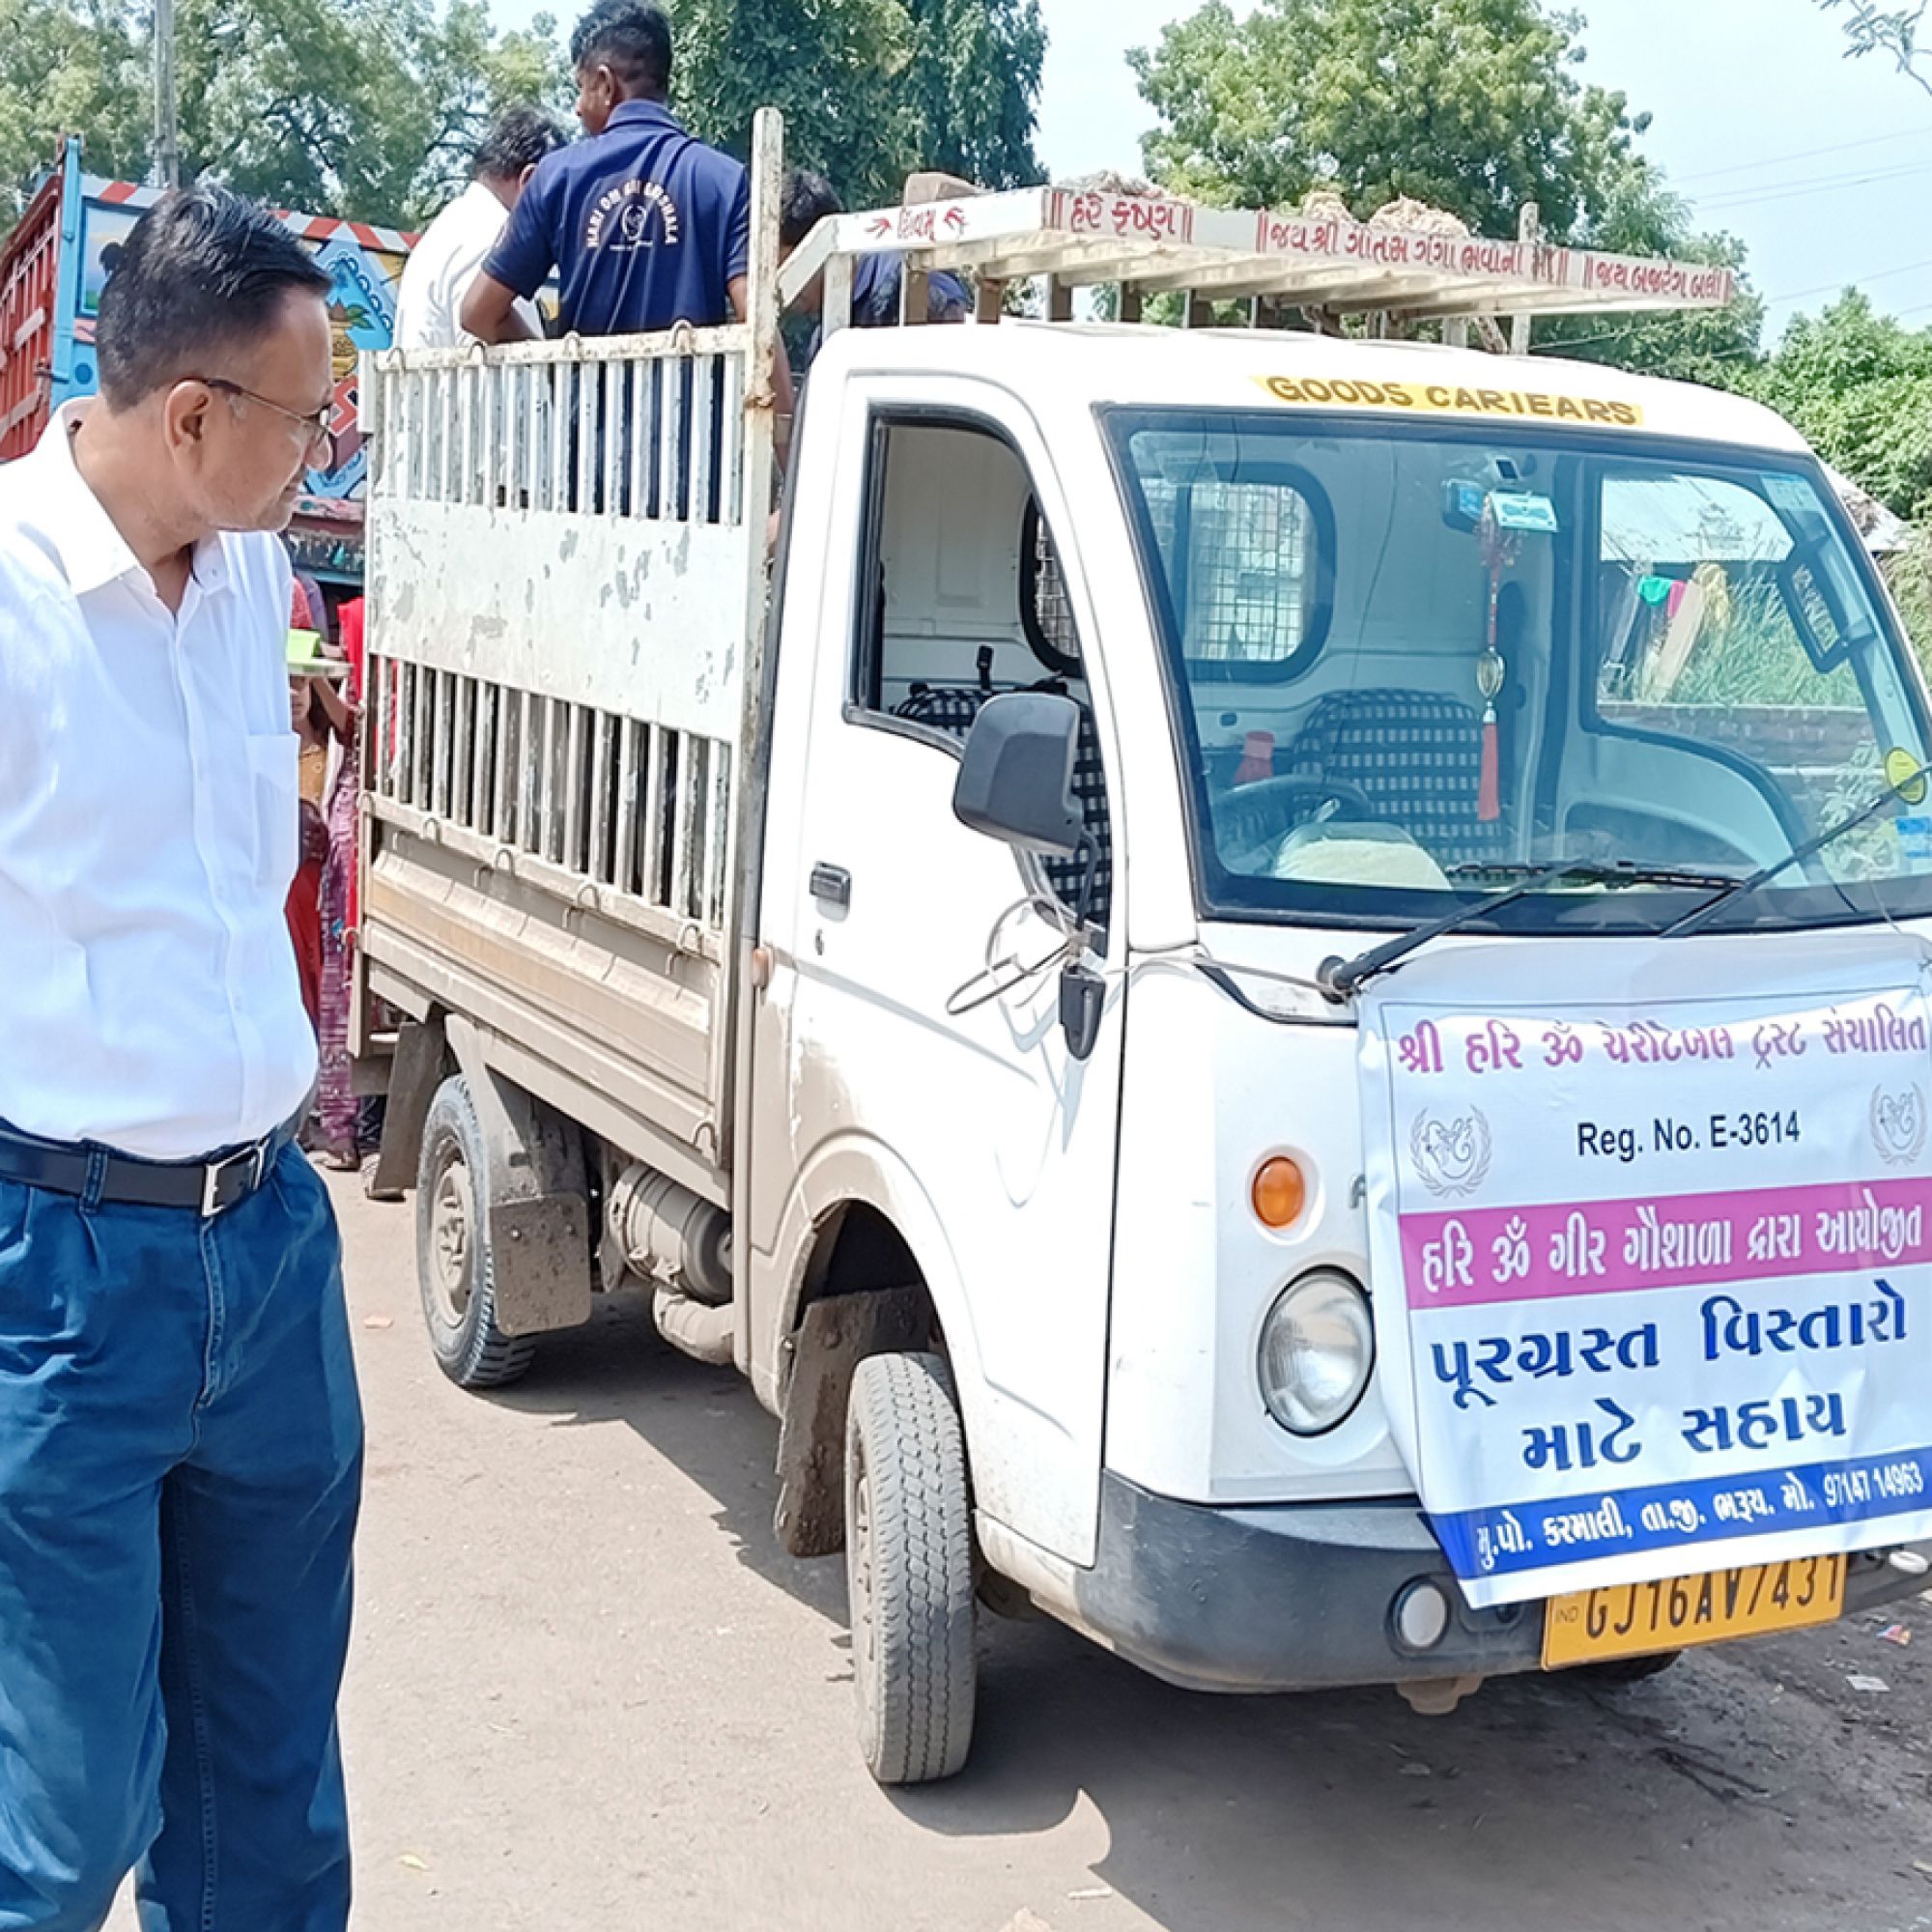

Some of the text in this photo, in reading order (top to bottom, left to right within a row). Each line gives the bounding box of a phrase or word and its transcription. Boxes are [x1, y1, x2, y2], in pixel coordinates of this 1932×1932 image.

[1270, 222, 1309, 252] જય
[1265, 376, 1636, 426] GOODS CARIEARS
[1398, 1019, 1444, 1073] શ્રી
[1465, 1019, 1523, 1074] હરિ
[1822, 1003, 1926, 1055] સંચાલિત
[1577, 1109, 1802, 1163] Reg. No. E-3614
[1422, 1218, 1474, 1293] હરિ
[1548, 1211, 1607, 1276] ગીર
[1624, 1205, 1733, 1272] ગૌશાળા
[1429, 1279, 1908, 1409] પૂરગ્રસ્ત વિસ્તારો
[1521, 1392, 1847, 1471] માટે સહાય
